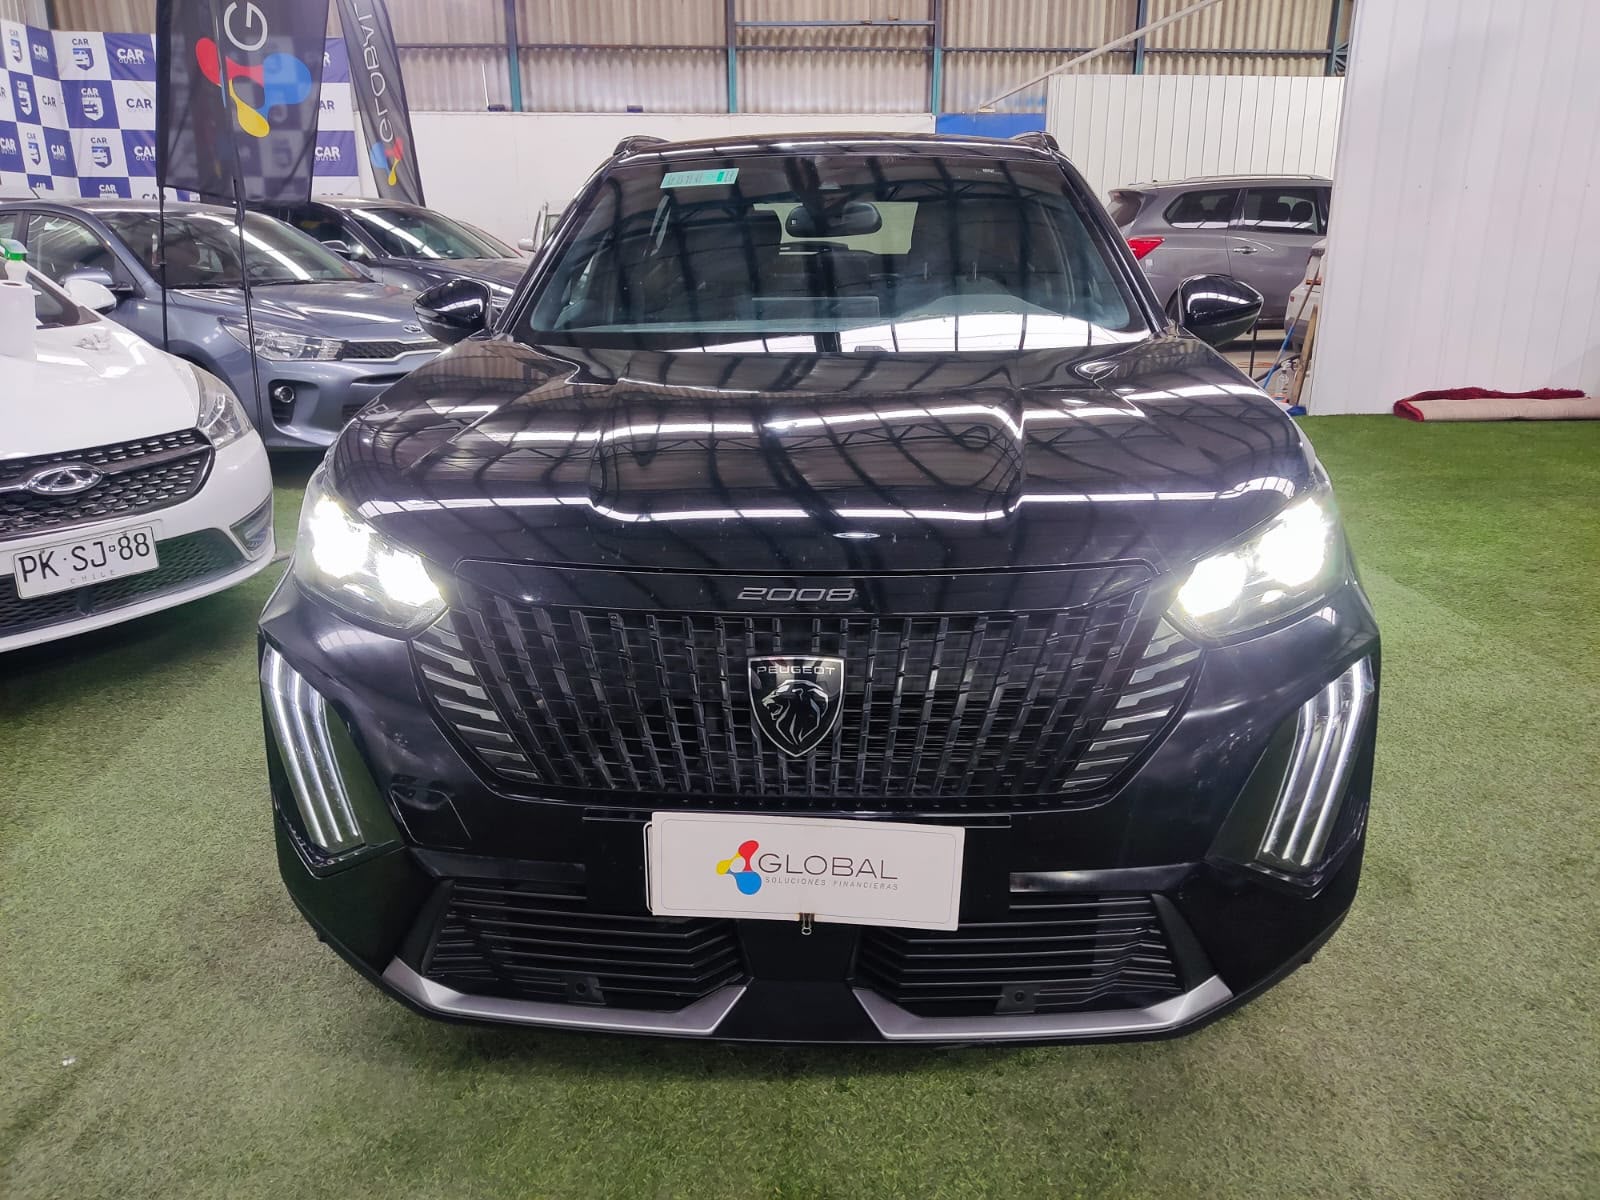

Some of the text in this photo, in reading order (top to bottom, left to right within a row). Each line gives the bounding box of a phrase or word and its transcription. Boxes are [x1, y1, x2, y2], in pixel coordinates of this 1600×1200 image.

[72, 38, 89, 46] CAR
[117, 48, 145, 60] CAR
[81, 87, 99, 96] CAR
[42, 95, 57, 108] CAR
[126, 98, 153, 109] CAR
[318, 99, 335, 110] AR
[315, 145, 340, 157] CAR
[98, 184, 117, 192] CAR
[70, 569, 116, 584] CHILE
[737, 586, 857, 603] 2008
[756, 664, 837, 676] PEUGEOT
[758, 852, 898, 880] GLOBAL
[764, 876, 899, 891] SOLUCIONES FINANCIERAS
